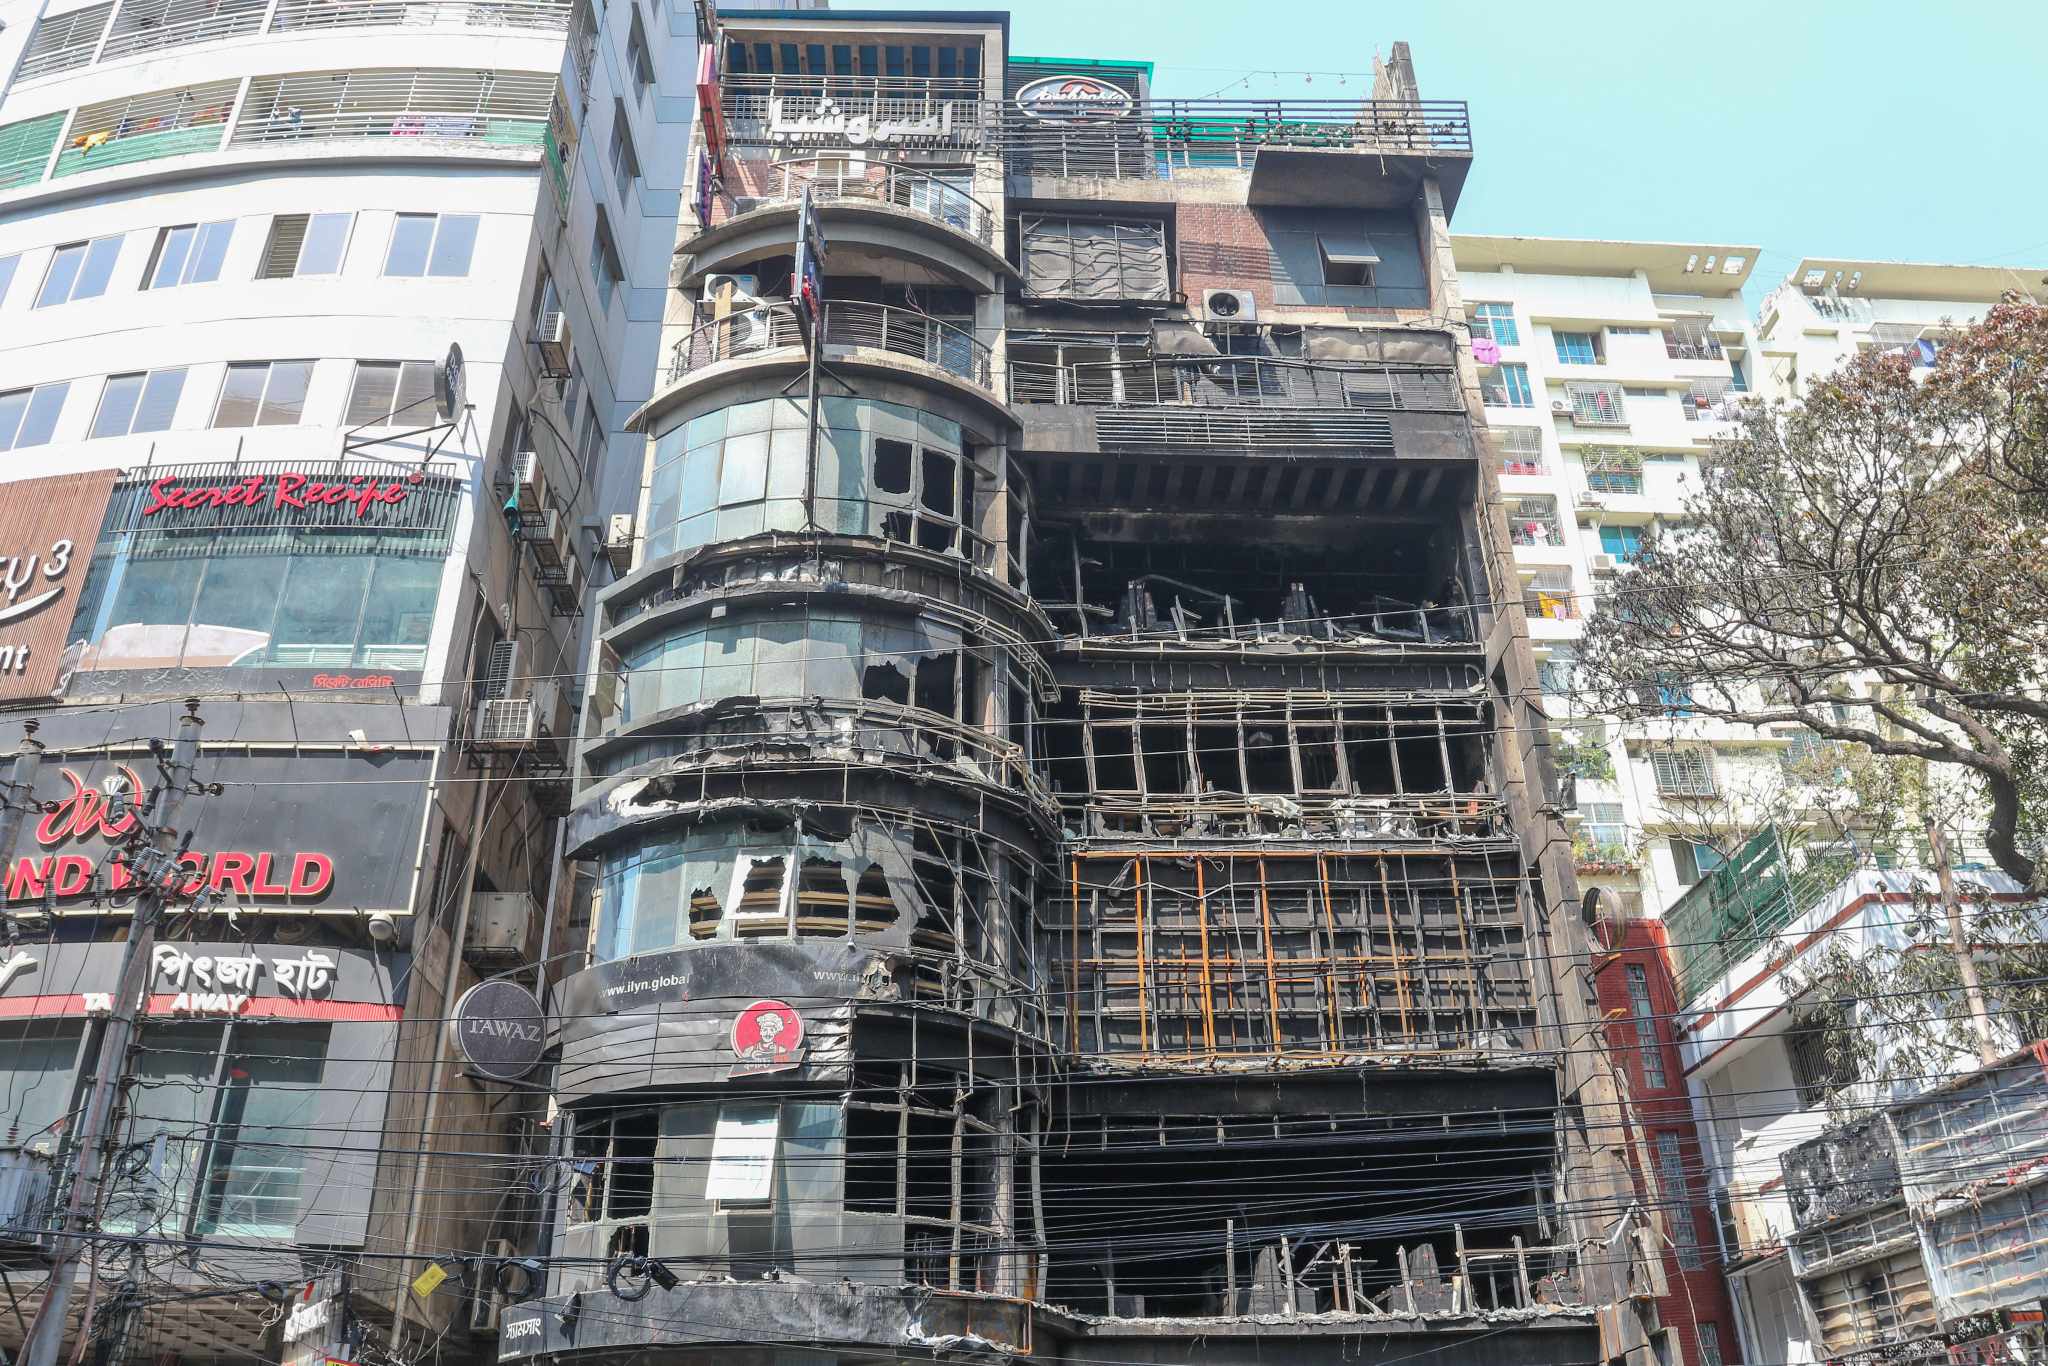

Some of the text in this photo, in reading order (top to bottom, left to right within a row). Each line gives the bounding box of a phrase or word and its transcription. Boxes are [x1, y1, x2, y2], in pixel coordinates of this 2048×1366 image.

[143, 472, 407, 517] Secret Recipe
[43, 539, 72, 577] 3
[150, 944, 336, 994] পিৎজা হাট
[600, 973, 690, 997] www.ilyn.global
[170, 991, 249, 1012] AWAY
[465, 1015, 541, 1042] TAWAZ
[505, 1317, 542, 1340] স্যামসাং
